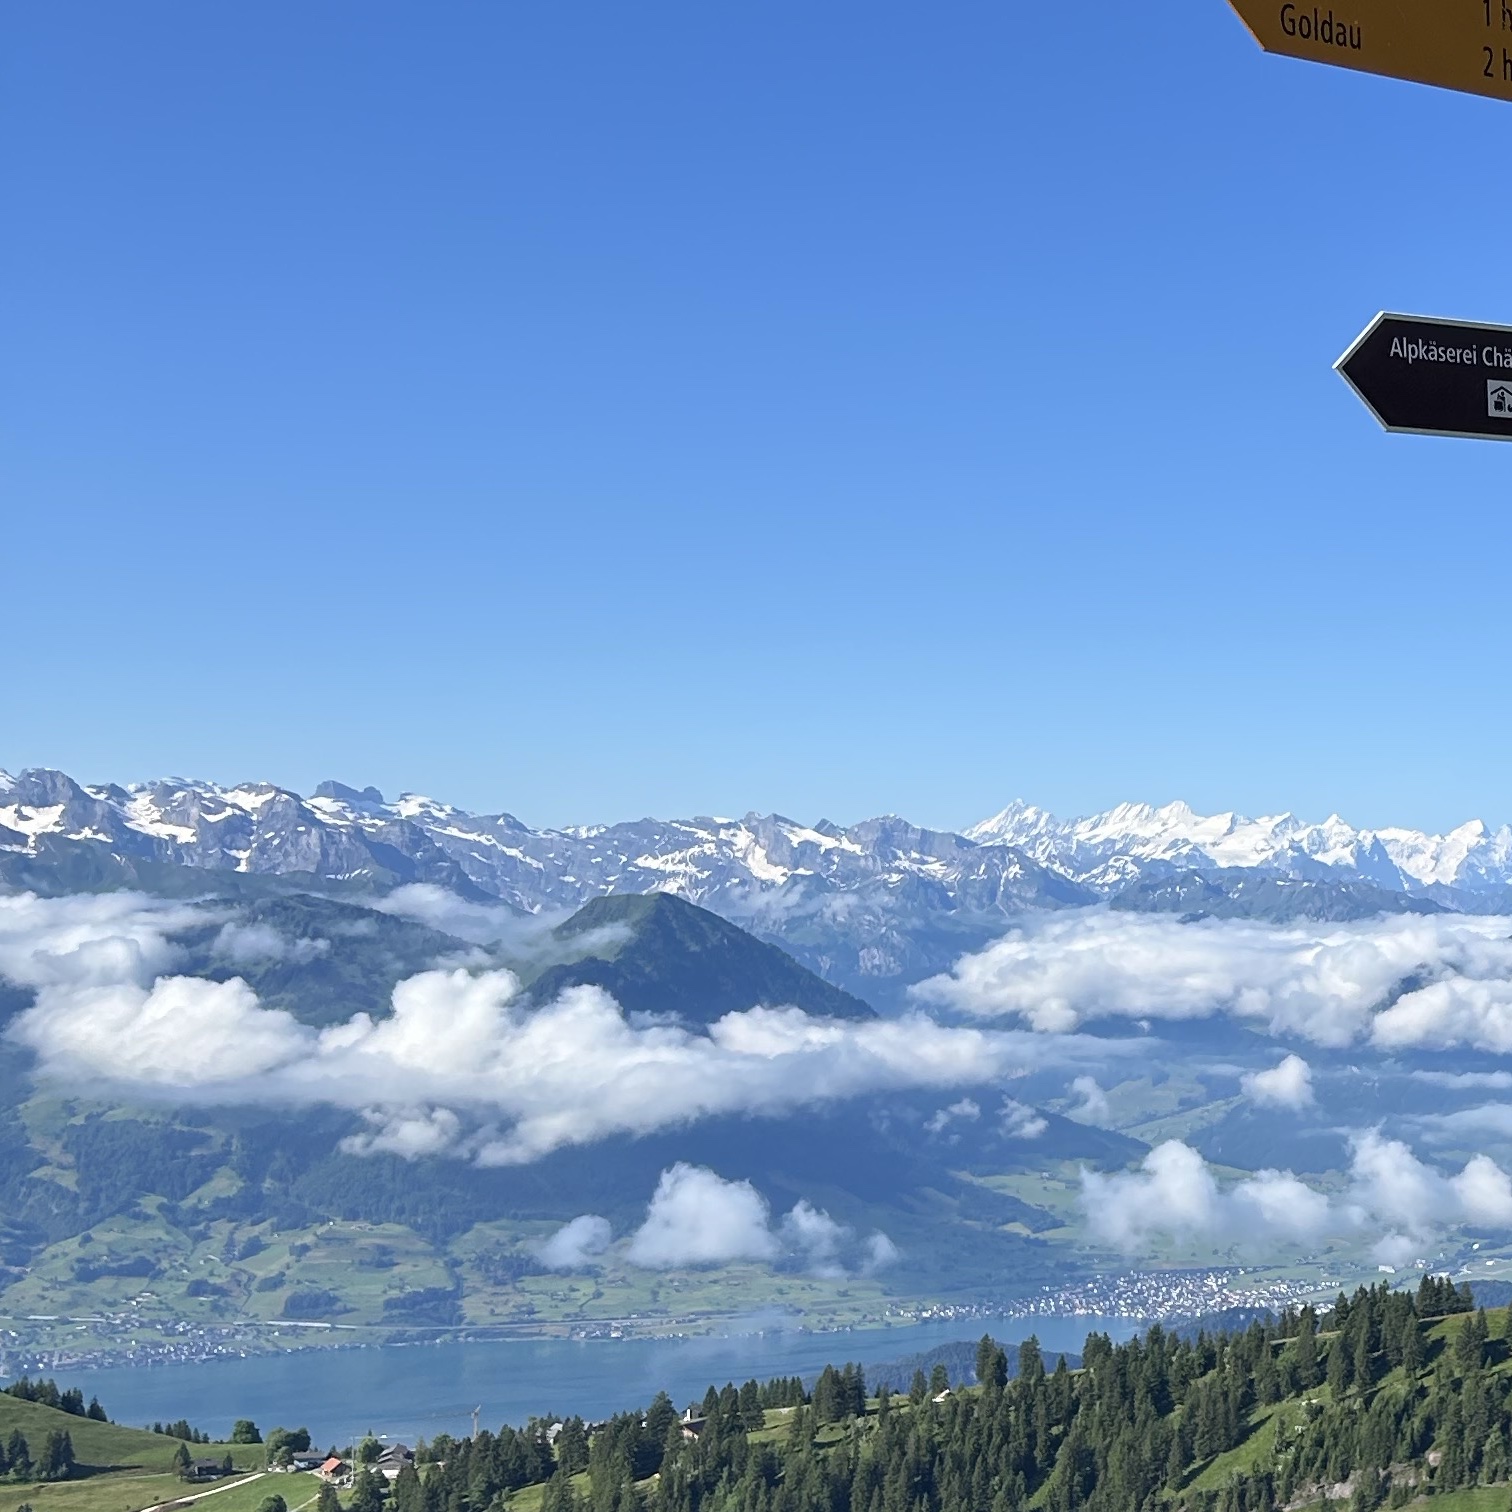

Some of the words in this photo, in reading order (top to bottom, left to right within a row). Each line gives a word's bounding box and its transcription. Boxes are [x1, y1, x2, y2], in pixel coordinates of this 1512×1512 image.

[1483, 0, 1492, 27] 1
[1280, 3, 1362, 50] Goldau
[1482, 46, 1494, 78] 2
[1389, 336, 1477, 366] Alpkäserei
